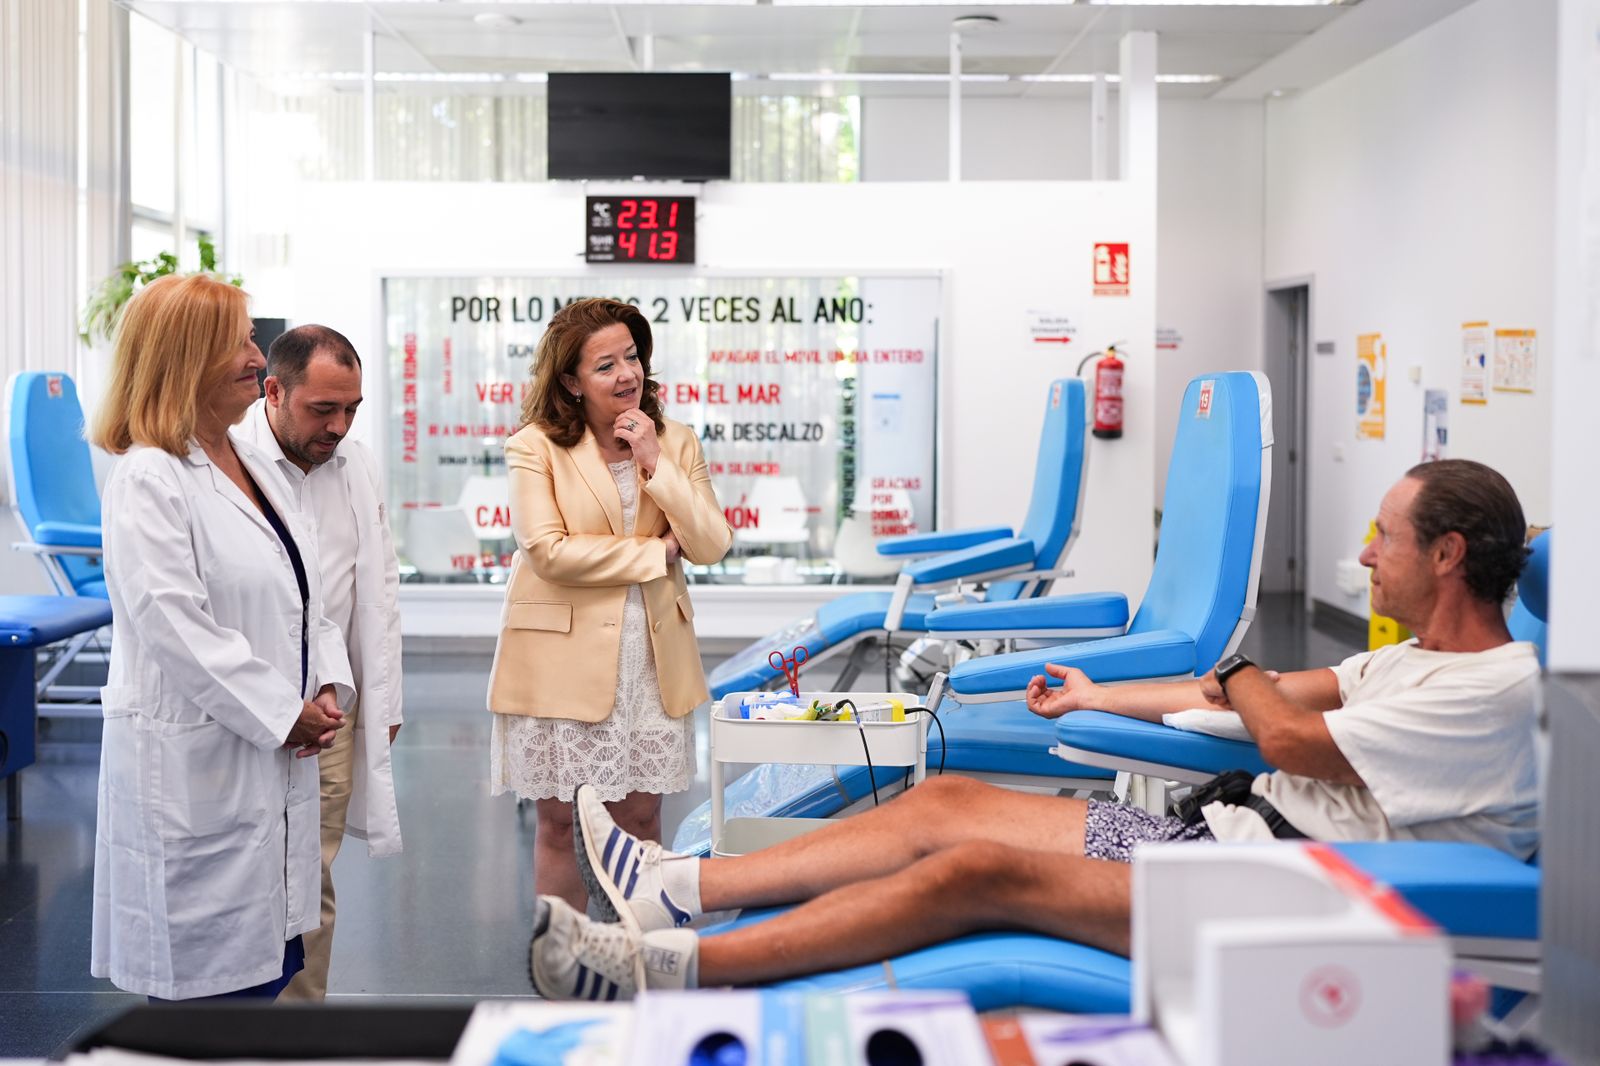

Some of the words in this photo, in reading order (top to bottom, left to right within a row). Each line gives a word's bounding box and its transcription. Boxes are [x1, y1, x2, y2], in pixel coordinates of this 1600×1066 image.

[452, 296, 500, 323] POR
[512, 296, 542, 323] LO
[652, 297, 670, 323] 2
[681, 297, 761, 323] VECES
[771, 297, 802, 323] AL
[709, 350, 760, 364] APAGAR
[765, 350, 778, 364] EL
[874, 350, 924, 364] ENTERO
[475, 383, 514, 405] VER
[676, 383, 699, 404] EN
[707, 383, 729, 404] EL
[737, 383, 781, 404] MAR
[403, 409, 417, 463] PASEAR
[732, 422, 824, 442] DESCALZO
[728, 462, 780, 475] SILENCIO
[872, 478, 921, 490] GRACIAS
[872, 494, 893, 504] POR
[450, 554, 476, 570] VER
